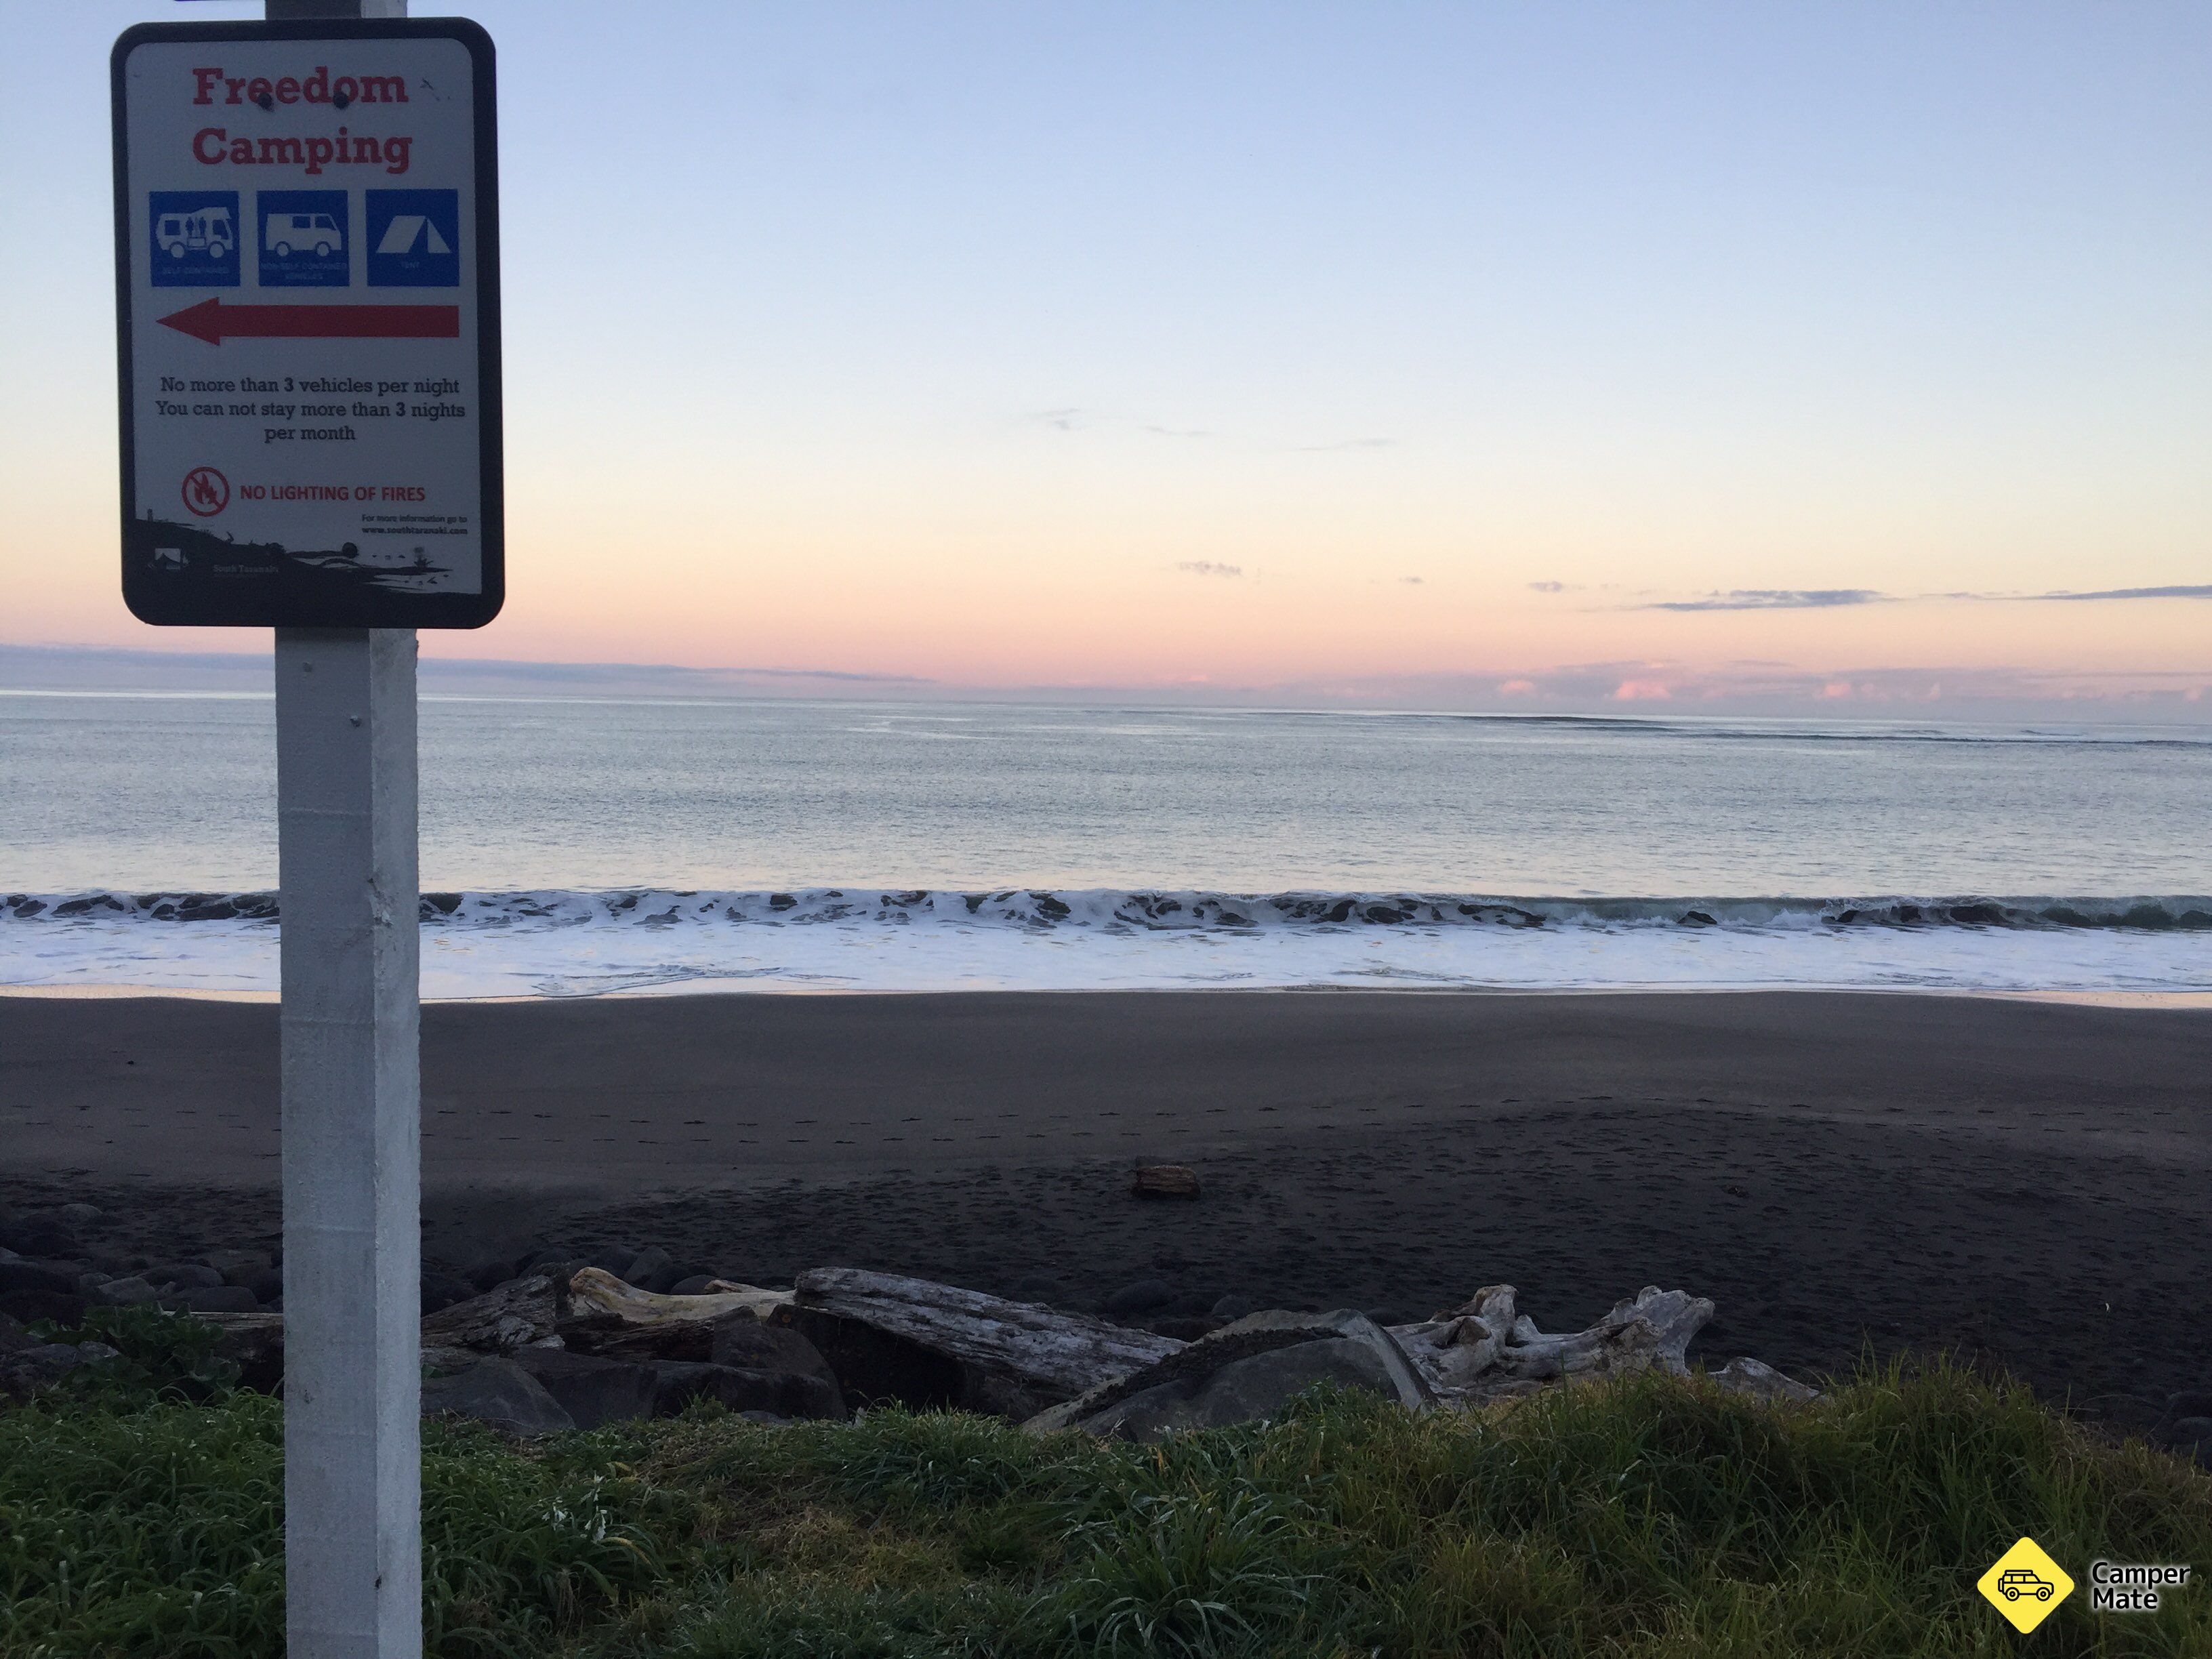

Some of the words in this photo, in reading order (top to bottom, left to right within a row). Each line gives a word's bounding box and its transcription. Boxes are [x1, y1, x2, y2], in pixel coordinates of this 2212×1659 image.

[192, 66, 409, 106] Freedom
[192, 127, 412, 174] Camping
[161, 377, 185, 392] No
[190, 380, 236, 392] more
[240, 377, 279, 392] than
[283, 377, 294, 392] 3
[299, 377, 373, 393] vehicles
[377, 381, 409, 396] per
[414, 378, 460, 397] night
[155, 401, 188, 415] You
[192, 404, 224, 415] can
[229, 403, 256, 415] not
[261, 403, 296, 420] stay
[300, 405, 347, 417] more
[352, 402, 390, 417] than
[396, 402, 406, 417] 3
[411, 403, 466, 422] nights
[264, 428, 295, 443] per
[300, 426, 356, 441] month
[240, 485, 266, 500] NO
[272, 486, 349, 501] LIGHTING
[354, 487, 376, 501] OF
[382, 487, 426, 501] FIRES
[362, 514, 374, 522] For
[399, 514, 445, 523] information
[362, 526, 468, 535] www.southtaranaki.com
